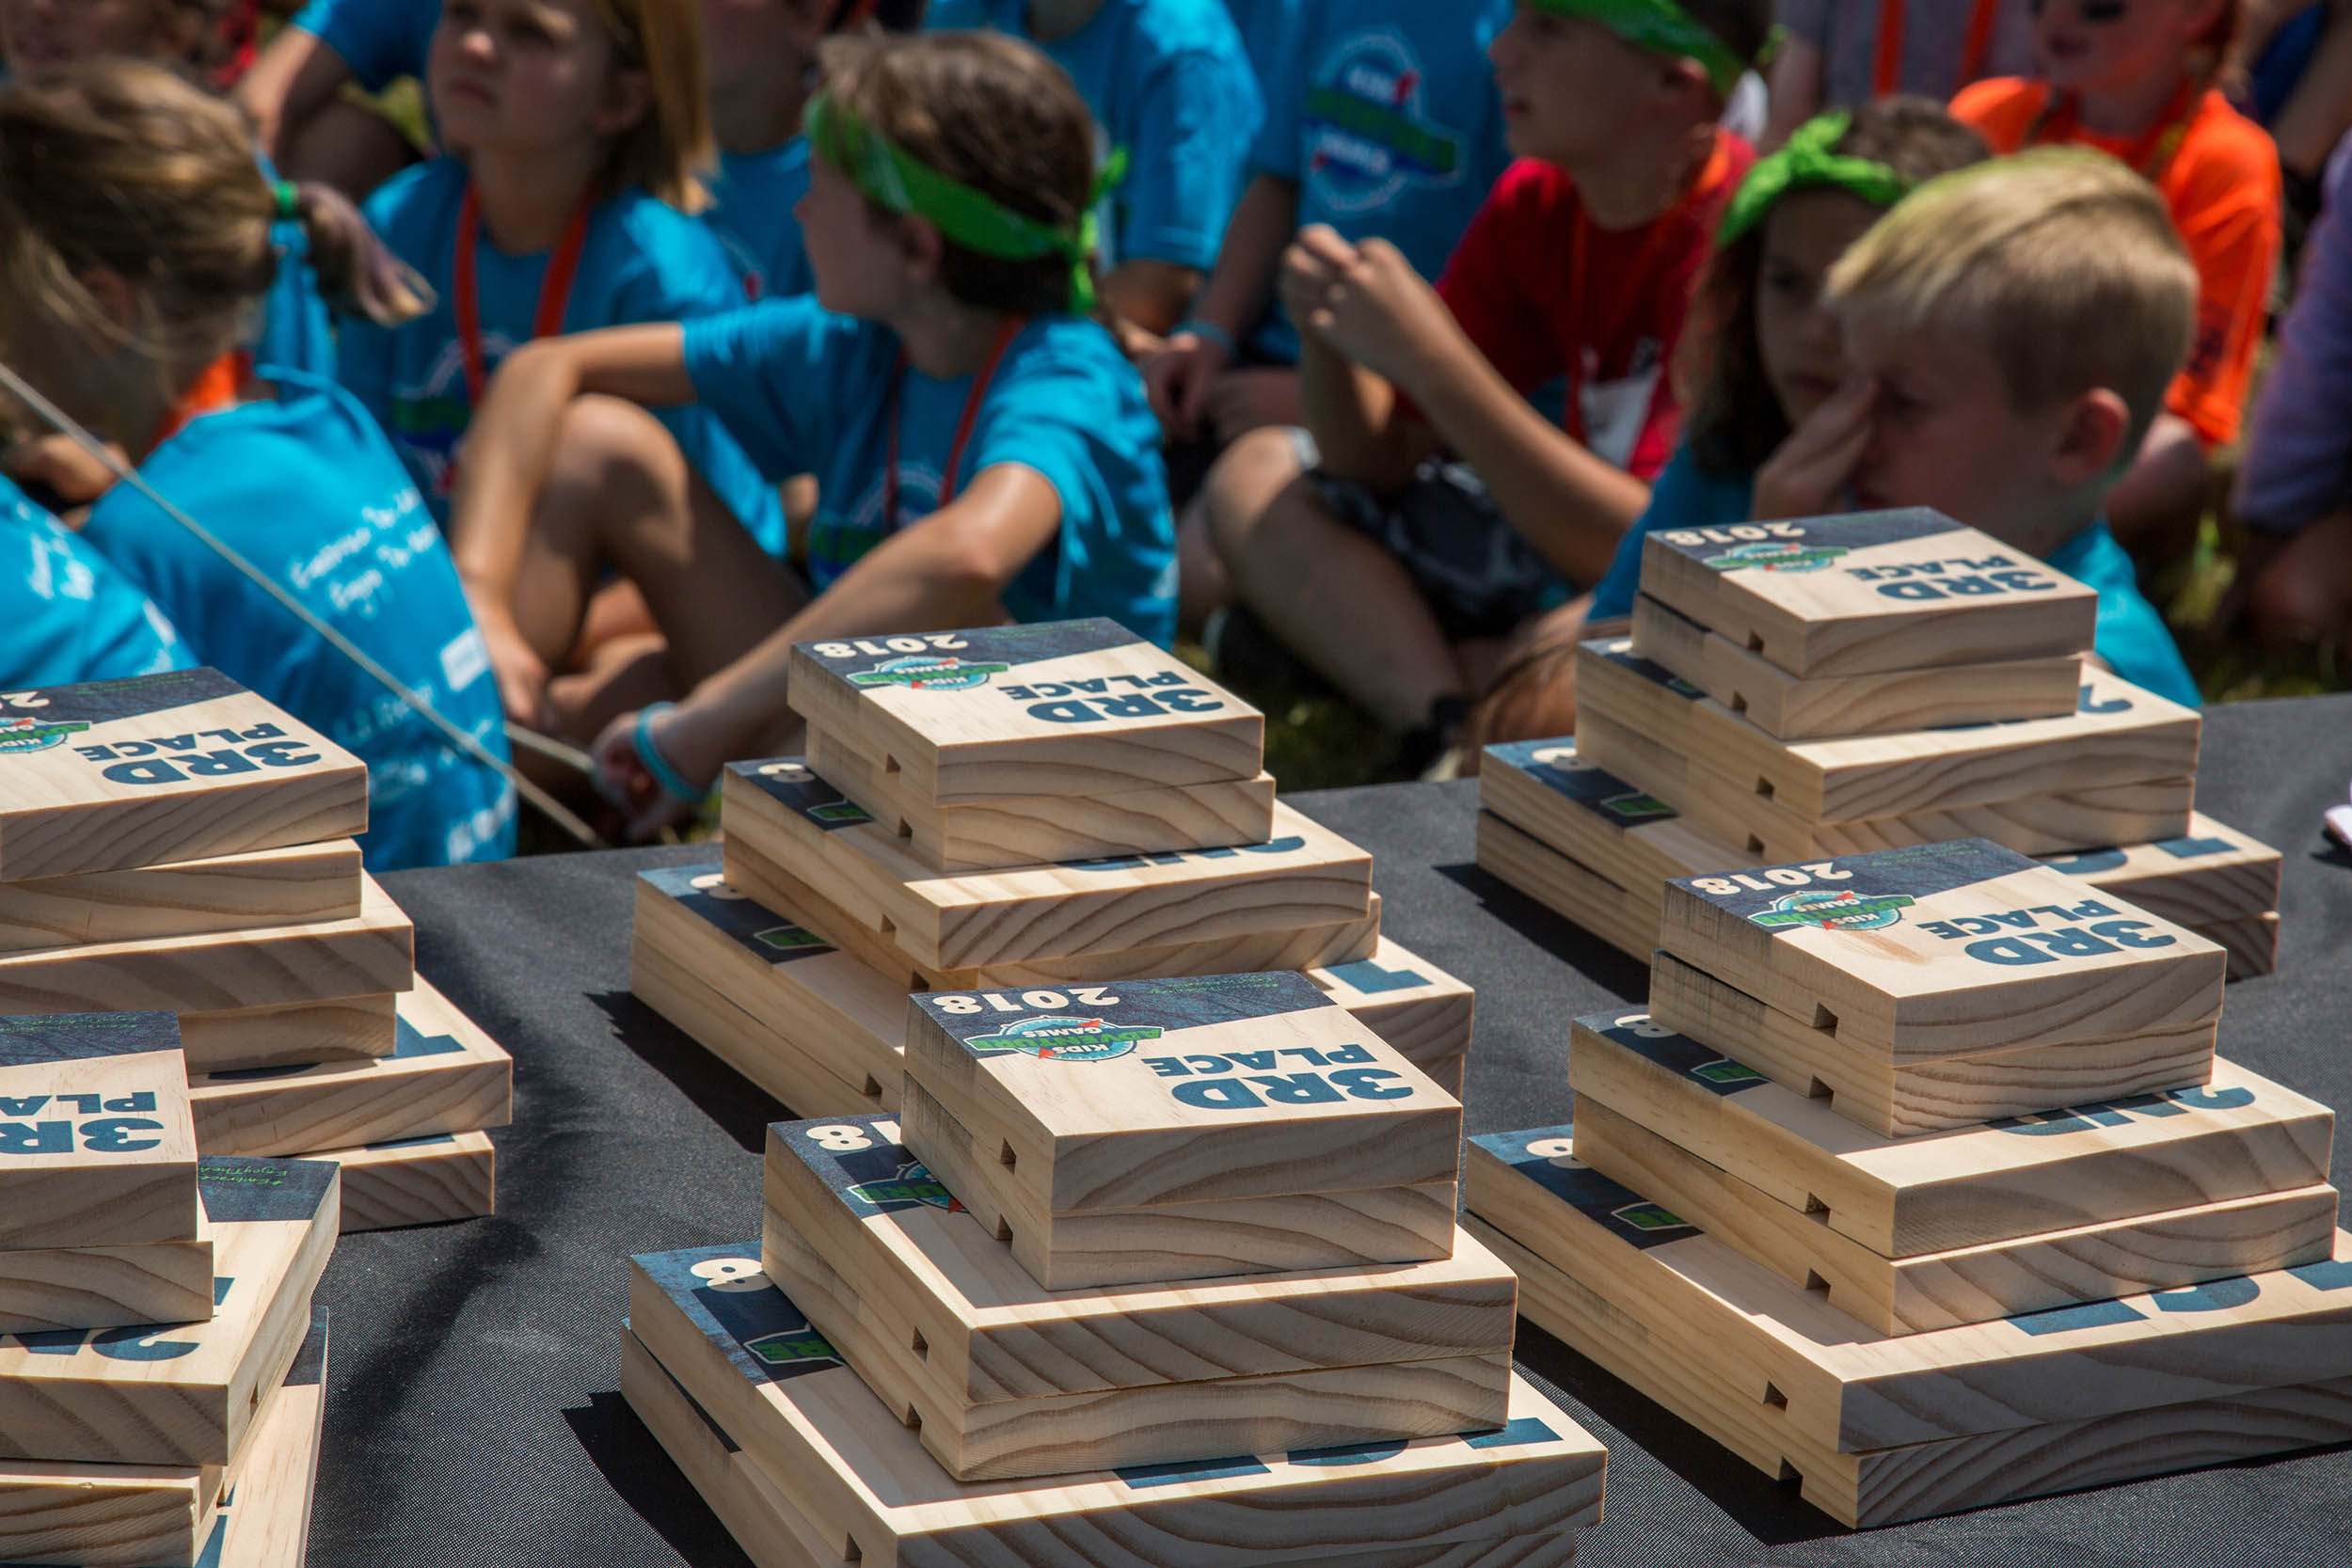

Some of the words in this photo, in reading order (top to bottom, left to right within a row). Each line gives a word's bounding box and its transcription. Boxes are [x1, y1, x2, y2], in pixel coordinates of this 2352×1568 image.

[1663, 522, 1806, 546] 2018
[1844, 554, 2019, 581] PLACE
[1876, 570, 2058, 601] 3RD
[812, 633, 969, 658] 2018
[996, 671, 1190, 700] PLACE
[1026, 688, 1224, 723] 3RD
[72, 722, 289, 762] PLACE
[102, 740, 322, 784] 3RD
[1691, 861, 1854, 895] 2018
[1791, 897, 1862, 912] GAMES
[1829, 912, 1881, 925] KIDS
[1916, 899, 2122, 941] PLACE
[1963, 919, 2177, 966] 3RD
[931, 987, 1120, 1014] 2018
[969, 1028, 1161, 1049] ADVENTURE
[1021, 1026, 1103, 1038] GAMES
[1051, 1043, 1110, 1054] KIDS
[1139, 1043, 1377, 1077] PLACE
[1171, 1068, 1413, 1110] 3RD
[0, 1091, 157, 1117] PLA
[0, 1117, 165, 1154] 3R
